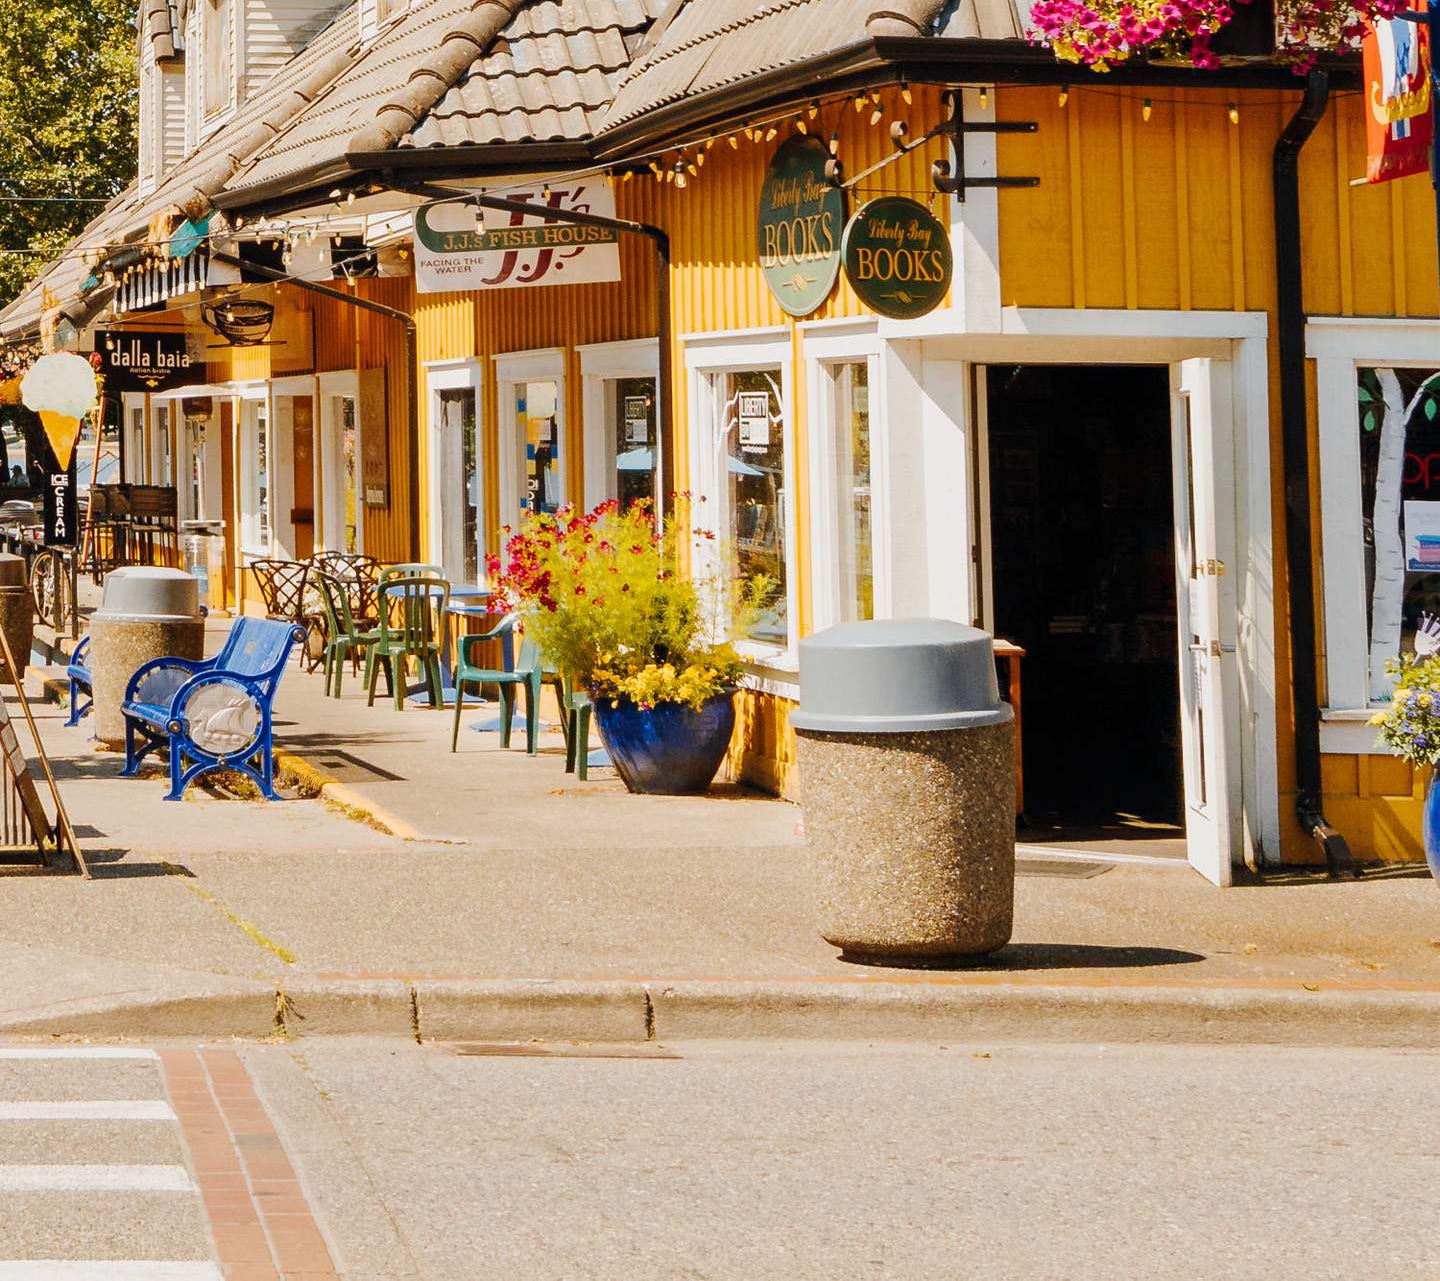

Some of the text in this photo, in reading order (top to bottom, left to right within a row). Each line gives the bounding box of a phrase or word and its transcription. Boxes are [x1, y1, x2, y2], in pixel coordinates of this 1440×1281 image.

[772, 177, 801, 214] Liberty
[488, 230, 537, 248] FISH
[543, 225, 613, 244] HOUSE
[764, 211, 834, 269] BOOKS
[868, 219, 932, 248] Liberty Bay
[420, 257, 484, 268] FACING THE
[435, 265, 472, 274] WATER
[856, 247, 945, 282] BOOKS
[110, 339, 191, 368] dalla baia
[51, 474, 68, 484] ICE
[54, 486, 66, 538] CREAM
